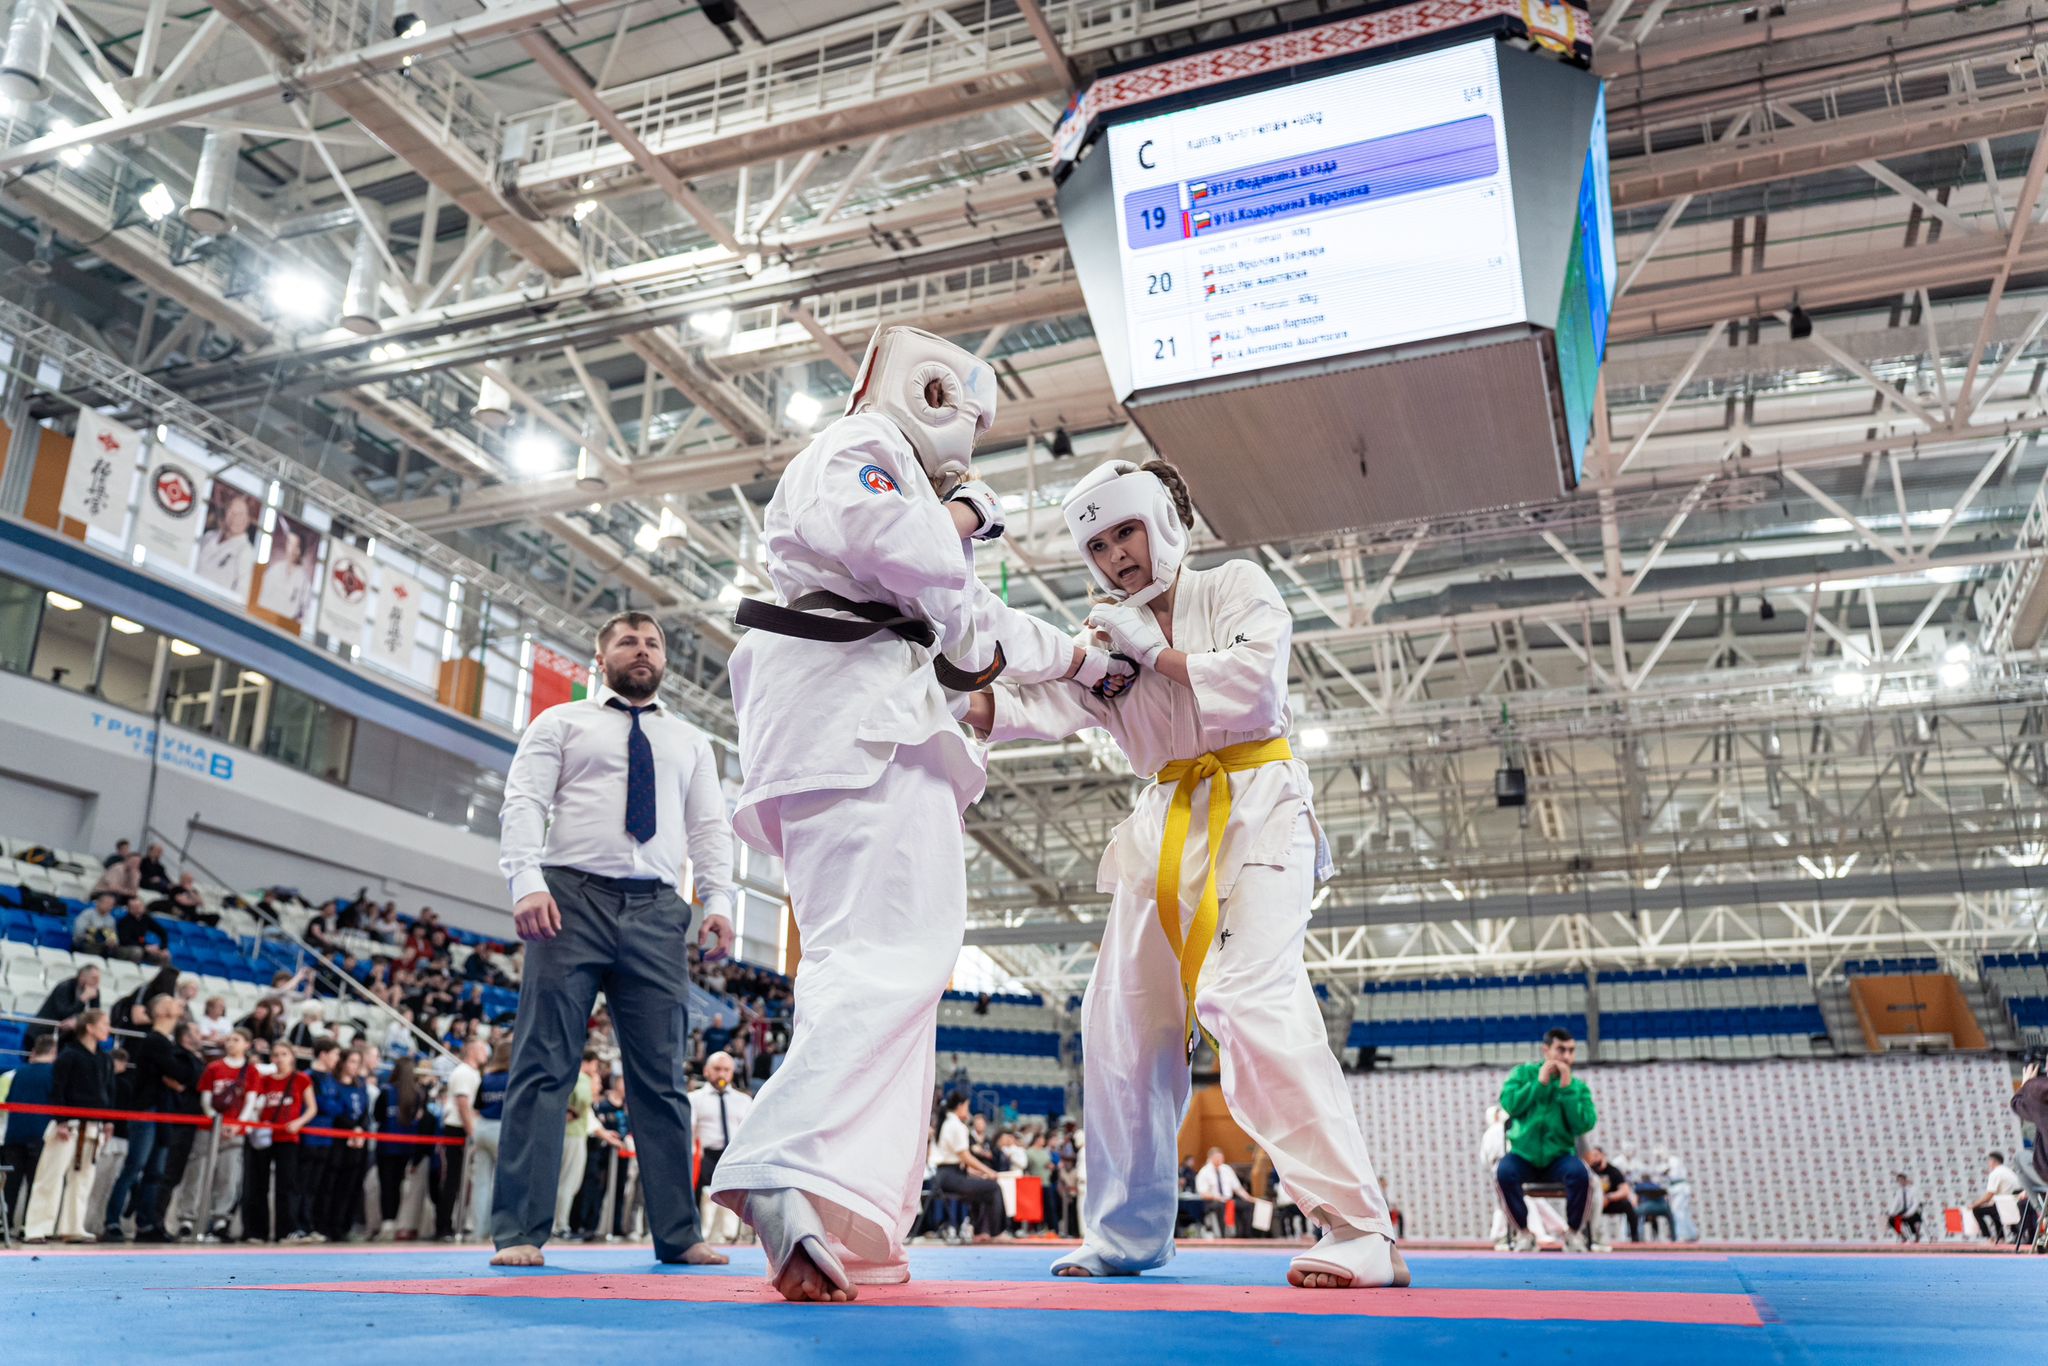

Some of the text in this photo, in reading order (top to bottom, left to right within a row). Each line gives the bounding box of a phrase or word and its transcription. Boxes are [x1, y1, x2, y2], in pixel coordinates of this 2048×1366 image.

[1138, 140, 1156, 169] C
[1140, 207, 1166, 230] 19
[1147, 272, 1172, 295] 20
[1154, 336, 1177, 360] 21
